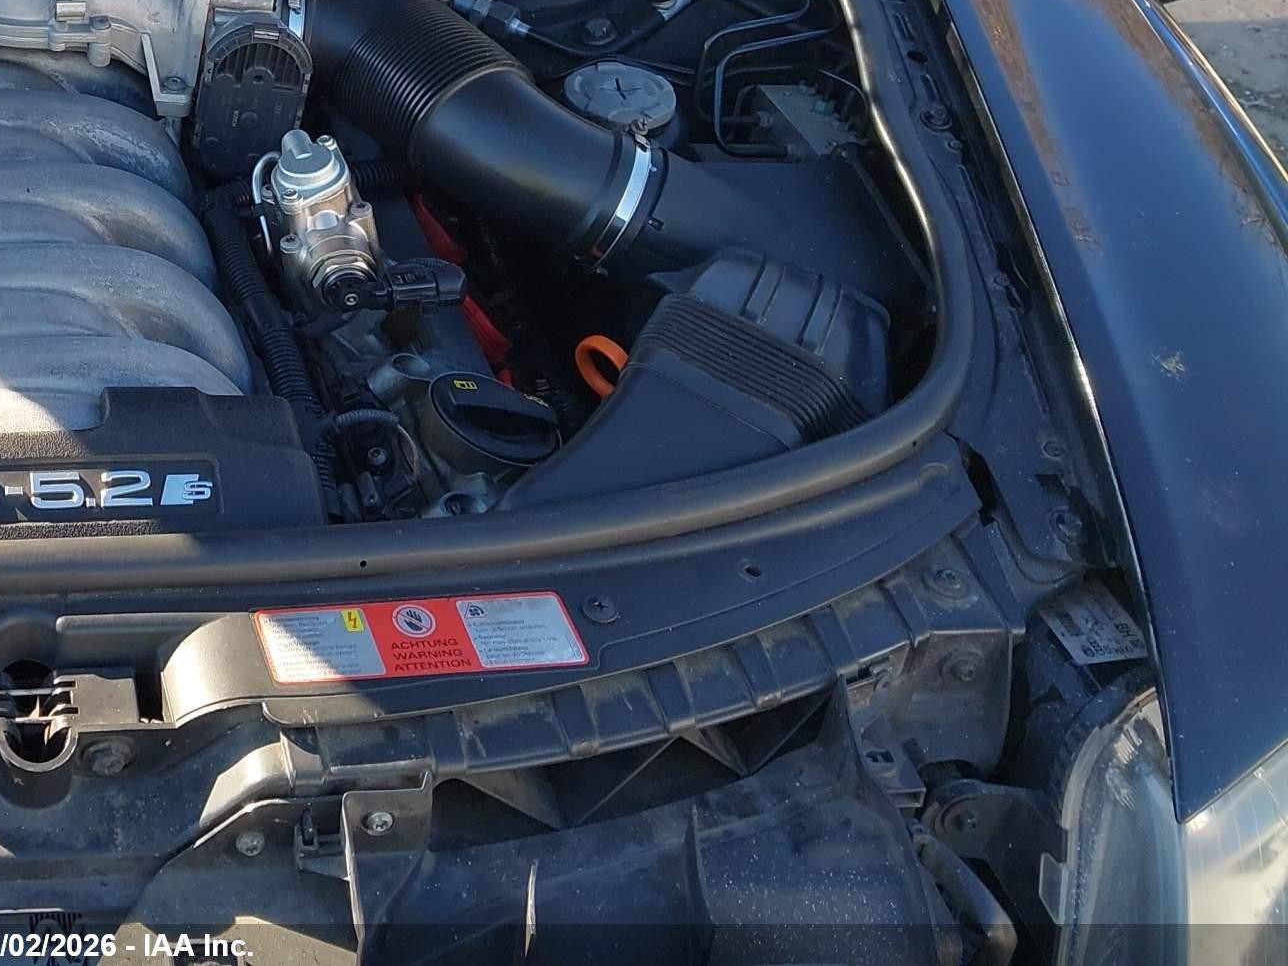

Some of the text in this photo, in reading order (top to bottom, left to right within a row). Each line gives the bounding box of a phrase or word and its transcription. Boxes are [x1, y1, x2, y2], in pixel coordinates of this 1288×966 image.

[391, 638, 459, 651] ACHTUNG
[393, 648, 463, 661] WARNING
[395, 658, 472, 672] ATTENTION
